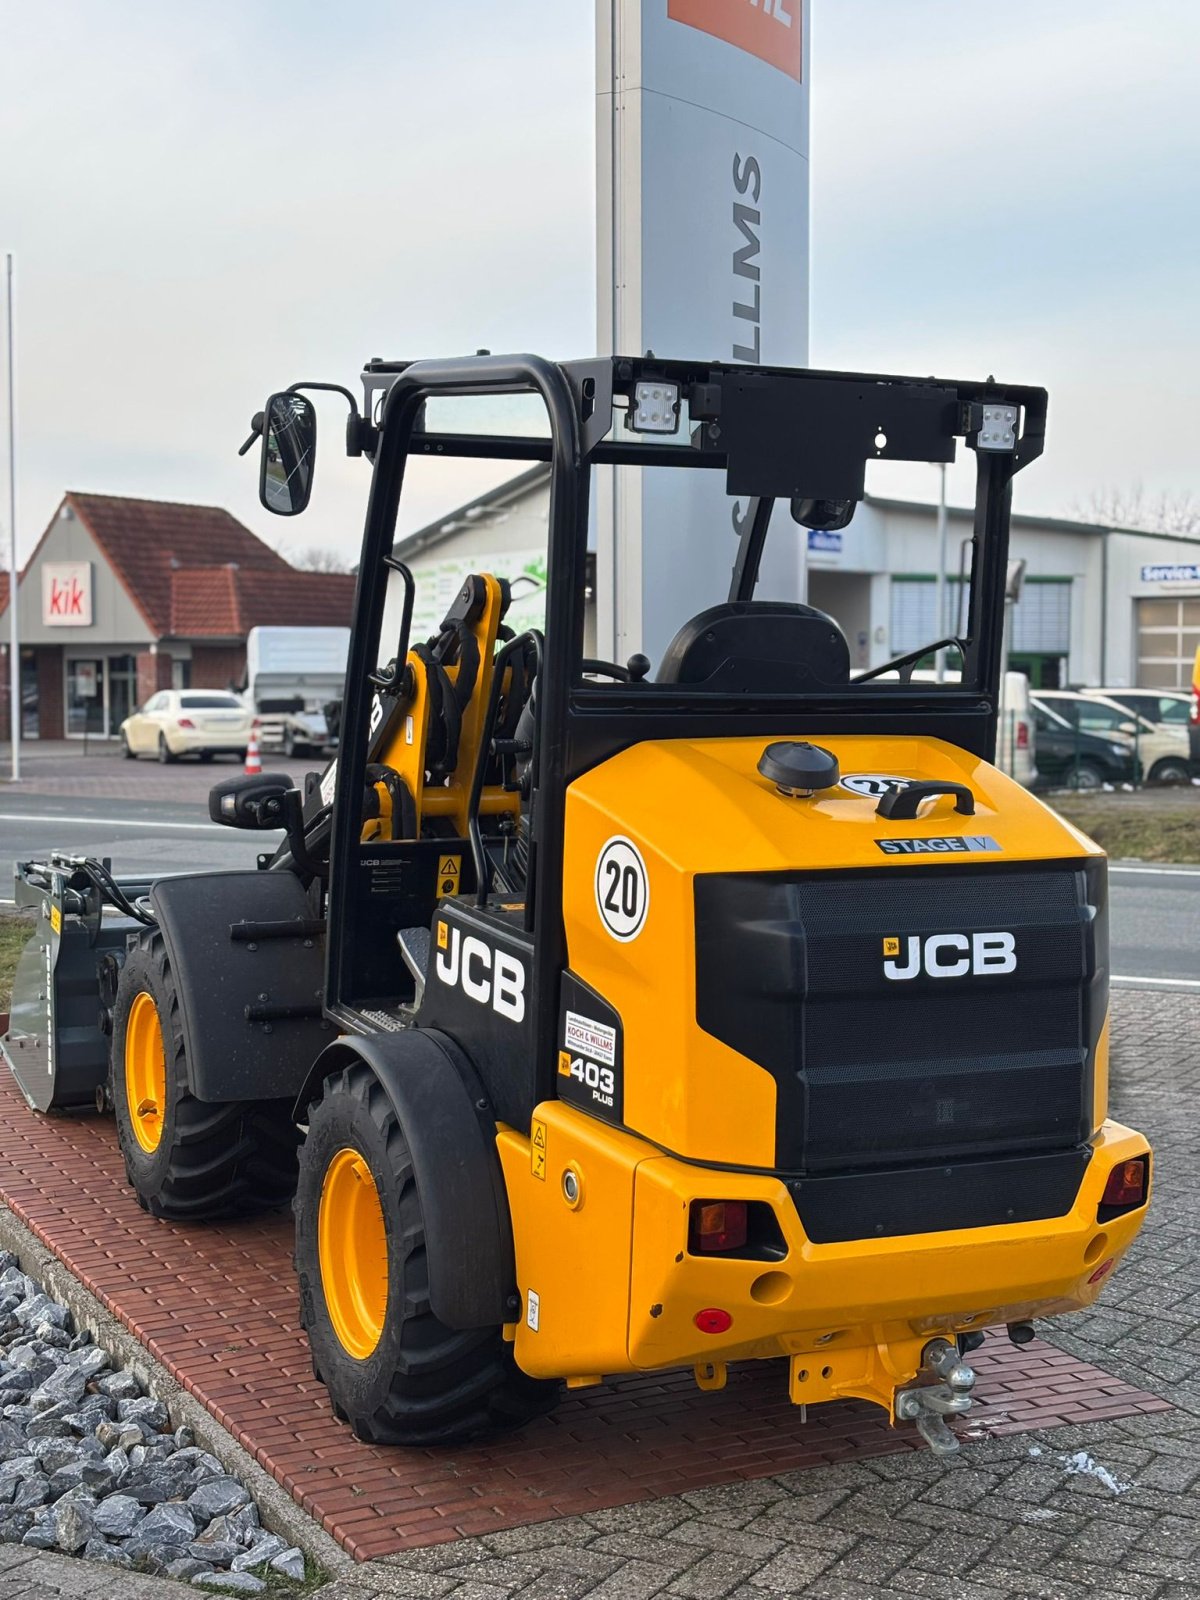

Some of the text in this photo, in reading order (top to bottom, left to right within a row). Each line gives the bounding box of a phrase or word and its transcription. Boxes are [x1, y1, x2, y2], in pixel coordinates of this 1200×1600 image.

[732, 151, 761, 365] LLMS
[879, 837, 987, 854] STAGE V
[604, 859, 638, 918] 20
[436, 927, 526, 1023] JCB
[883, 931, 1018, 981] JCB
[567, 1025, 584, 1039] KOCH
[590, 1033, 613, 1051] WILLMS
[570, 1057, 614, 1095] 403
[592, 1090, 614, 1107] PLUS
